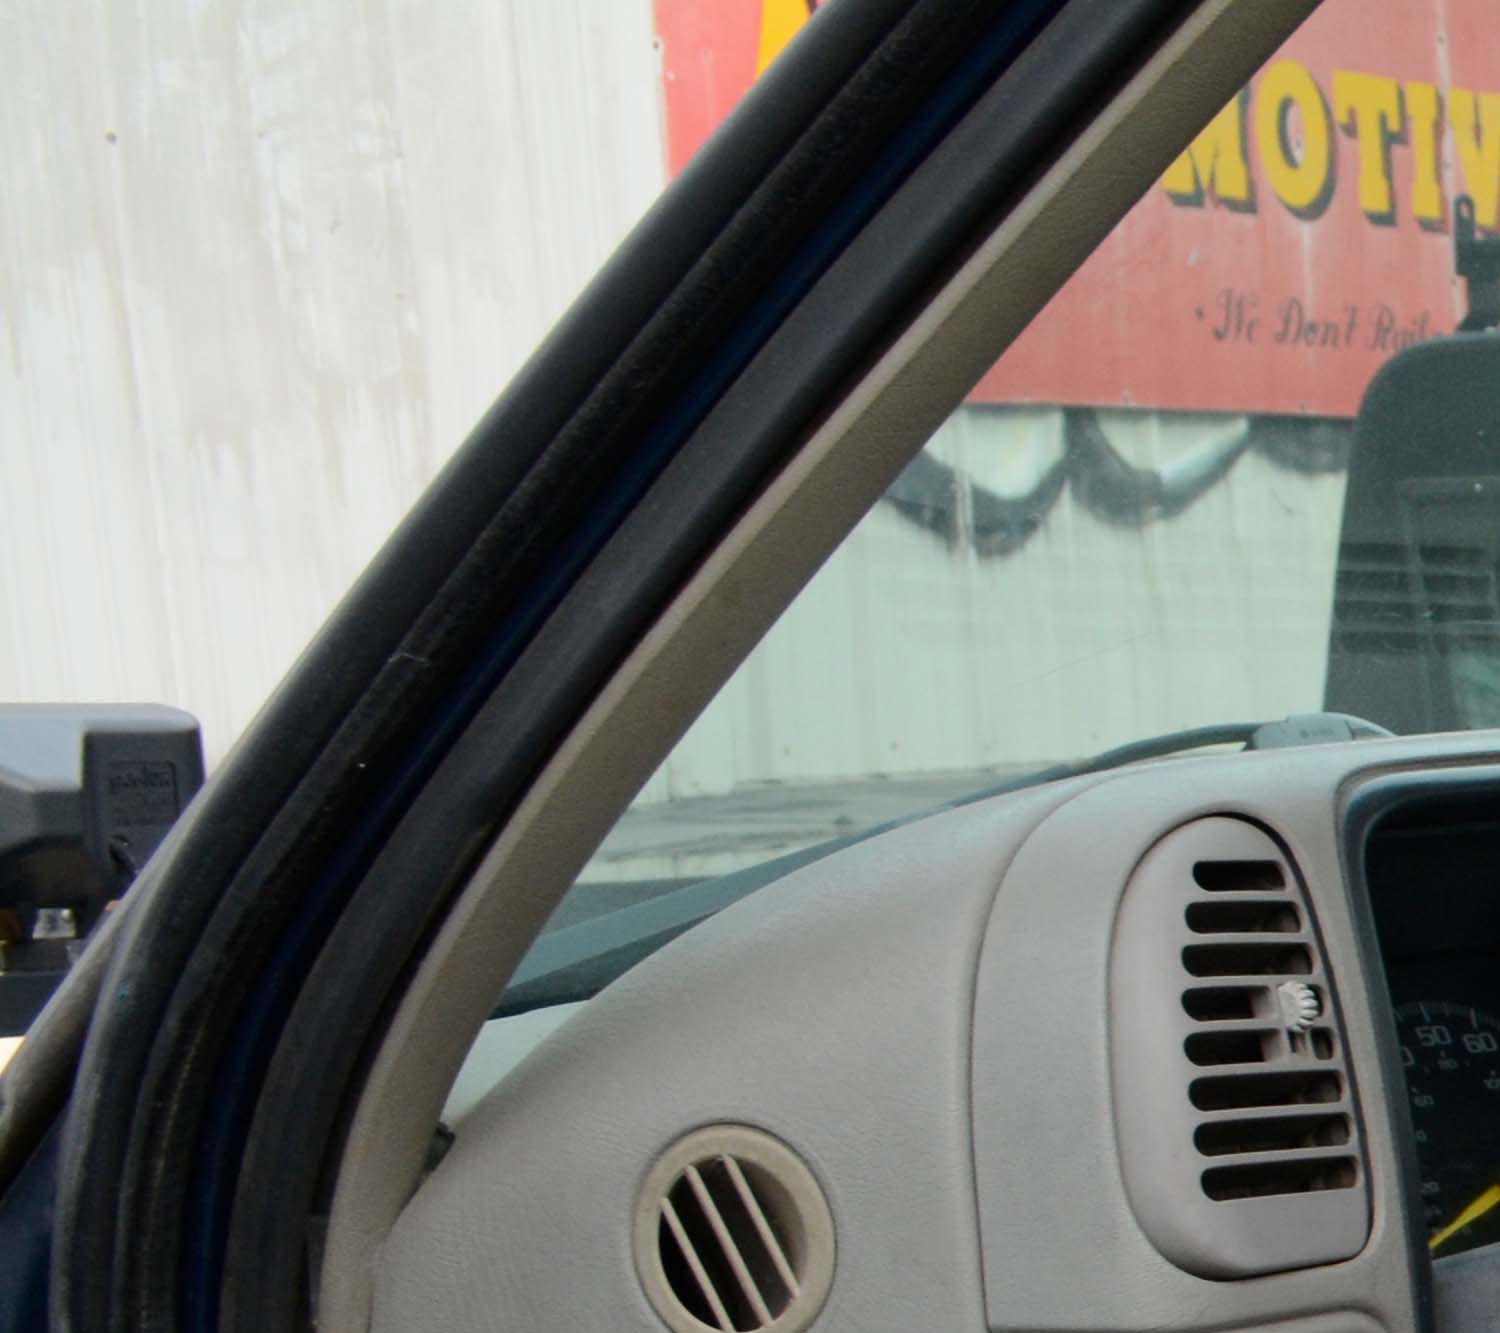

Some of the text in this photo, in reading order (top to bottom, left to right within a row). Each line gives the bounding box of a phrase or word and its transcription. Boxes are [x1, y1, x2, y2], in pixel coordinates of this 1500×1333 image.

[1275, 297, 1357, 346] Don't
[1415, 1025, 1453, 1047] 50
[1461, 1031, 1500, 1054] 60
